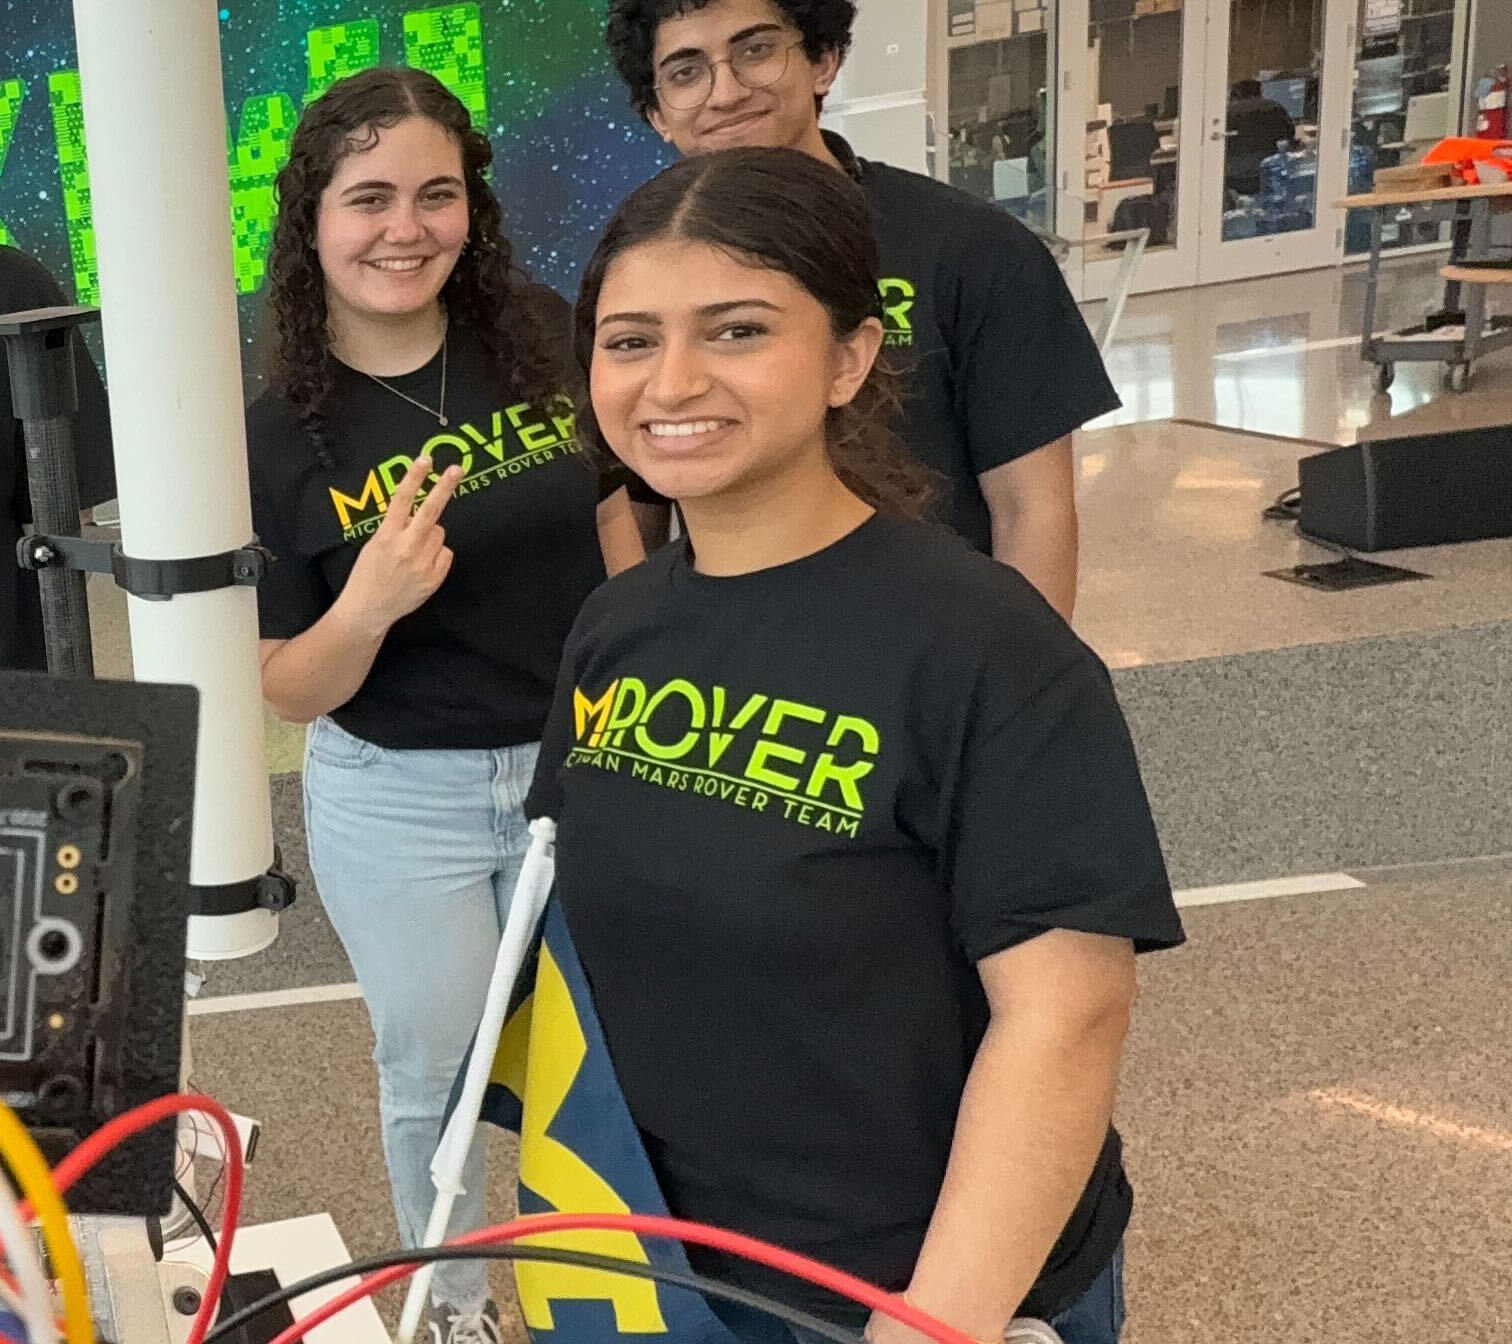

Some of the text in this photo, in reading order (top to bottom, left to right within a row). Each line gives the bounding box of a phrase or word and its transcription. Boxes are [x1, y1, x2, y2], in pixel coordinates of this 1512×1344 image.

[884, 335, 912, 346] AM
[496, 450, 554, 480] ROVER
[573, 676, 880, 812] MROVER
[631, 760, 689, 792] MARS
[693, 775, 768, 812] ROVER
[784, 798, 860, 839] TEAM
